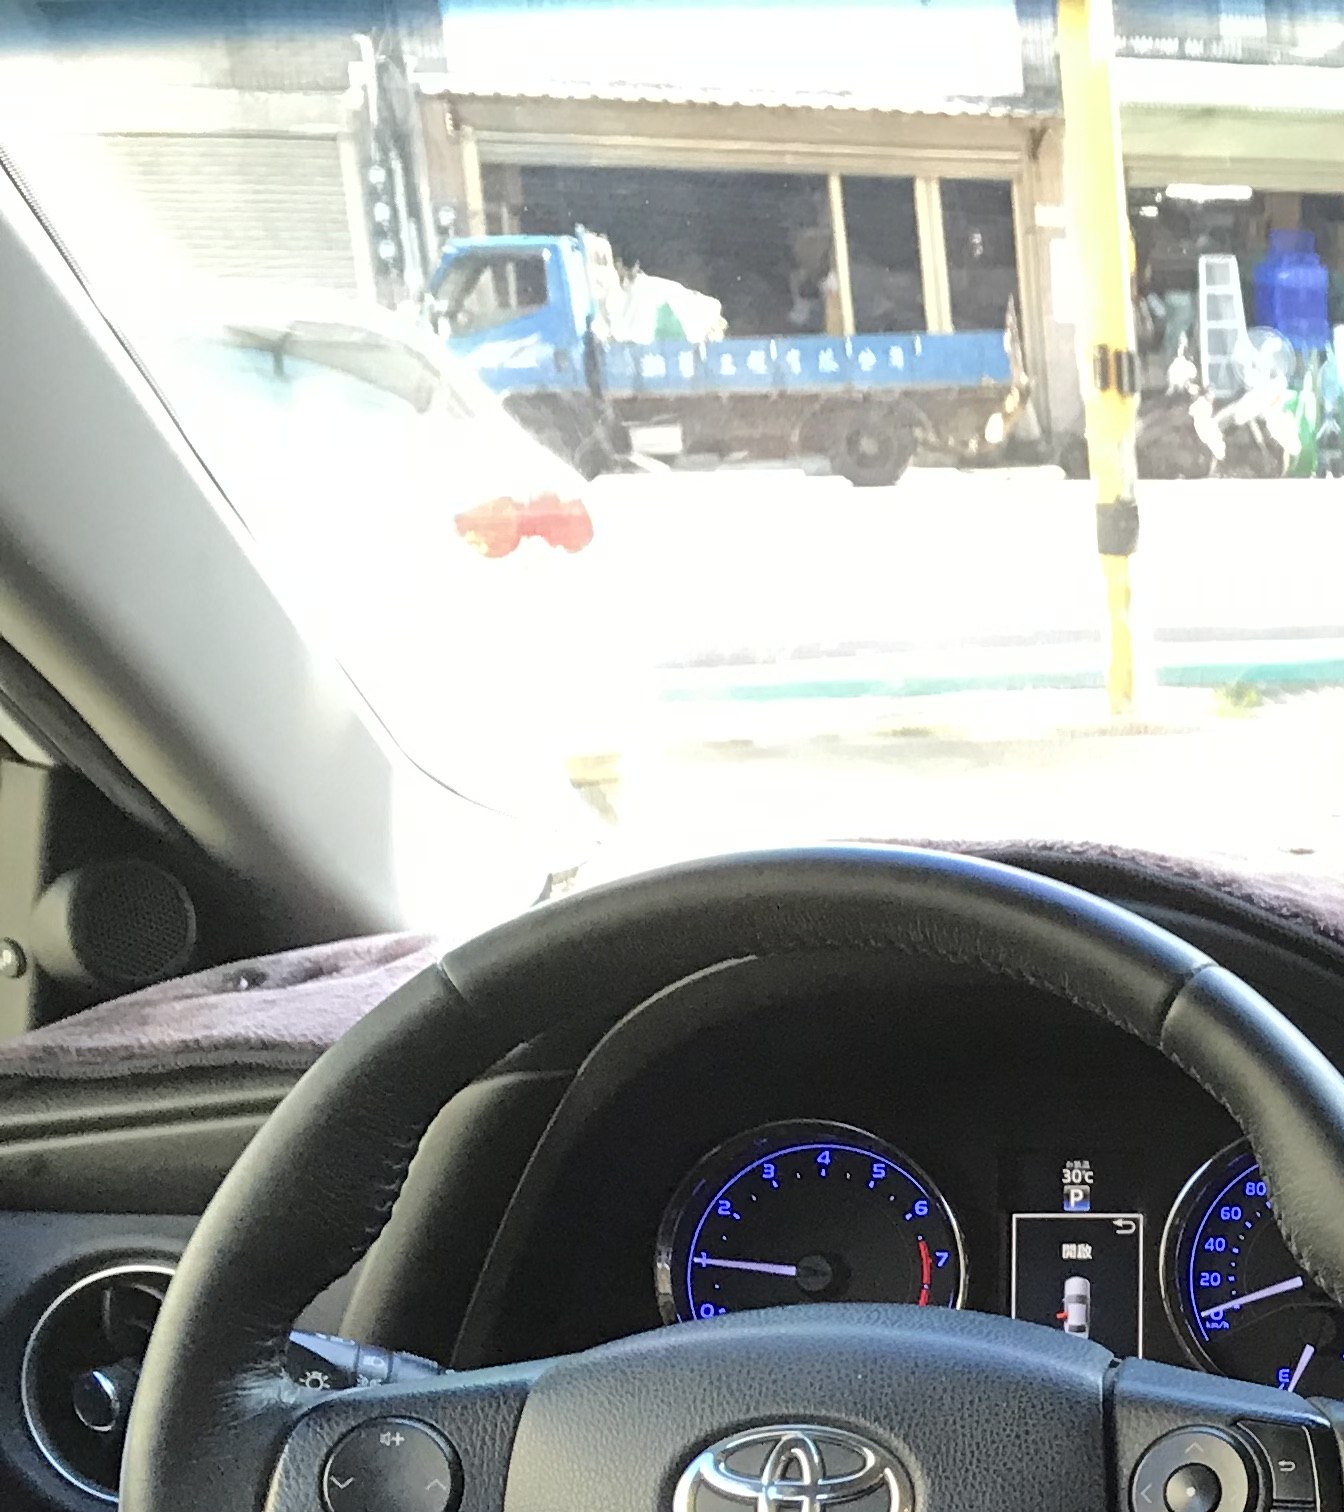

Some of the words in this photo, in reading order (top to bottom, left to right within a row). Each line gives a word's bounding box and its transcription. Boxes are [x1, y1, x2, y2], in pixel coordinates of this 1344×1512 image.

[816, 1151, 831, 1165] 4
[763, 1164, 775, 1178] 3
[872, 1164, 886, 1178] 5
[1245, 1182, 1267, 1196] 80
[1070, 1189, 1083, 1208] P
[718, 1201, 731, 1215] 2
[914, 1201, 927, 1215] 6
[1220, 1207, 1242, 1220] 60
[1204, 1238, 1226, 1252] 40
[935, 1252, 949, 1267] 7
[1200, 1273, 1221, 1286] 20
[701, 1304, 714, 1317] 0
[1279, 1369, 1289, 1382] E
